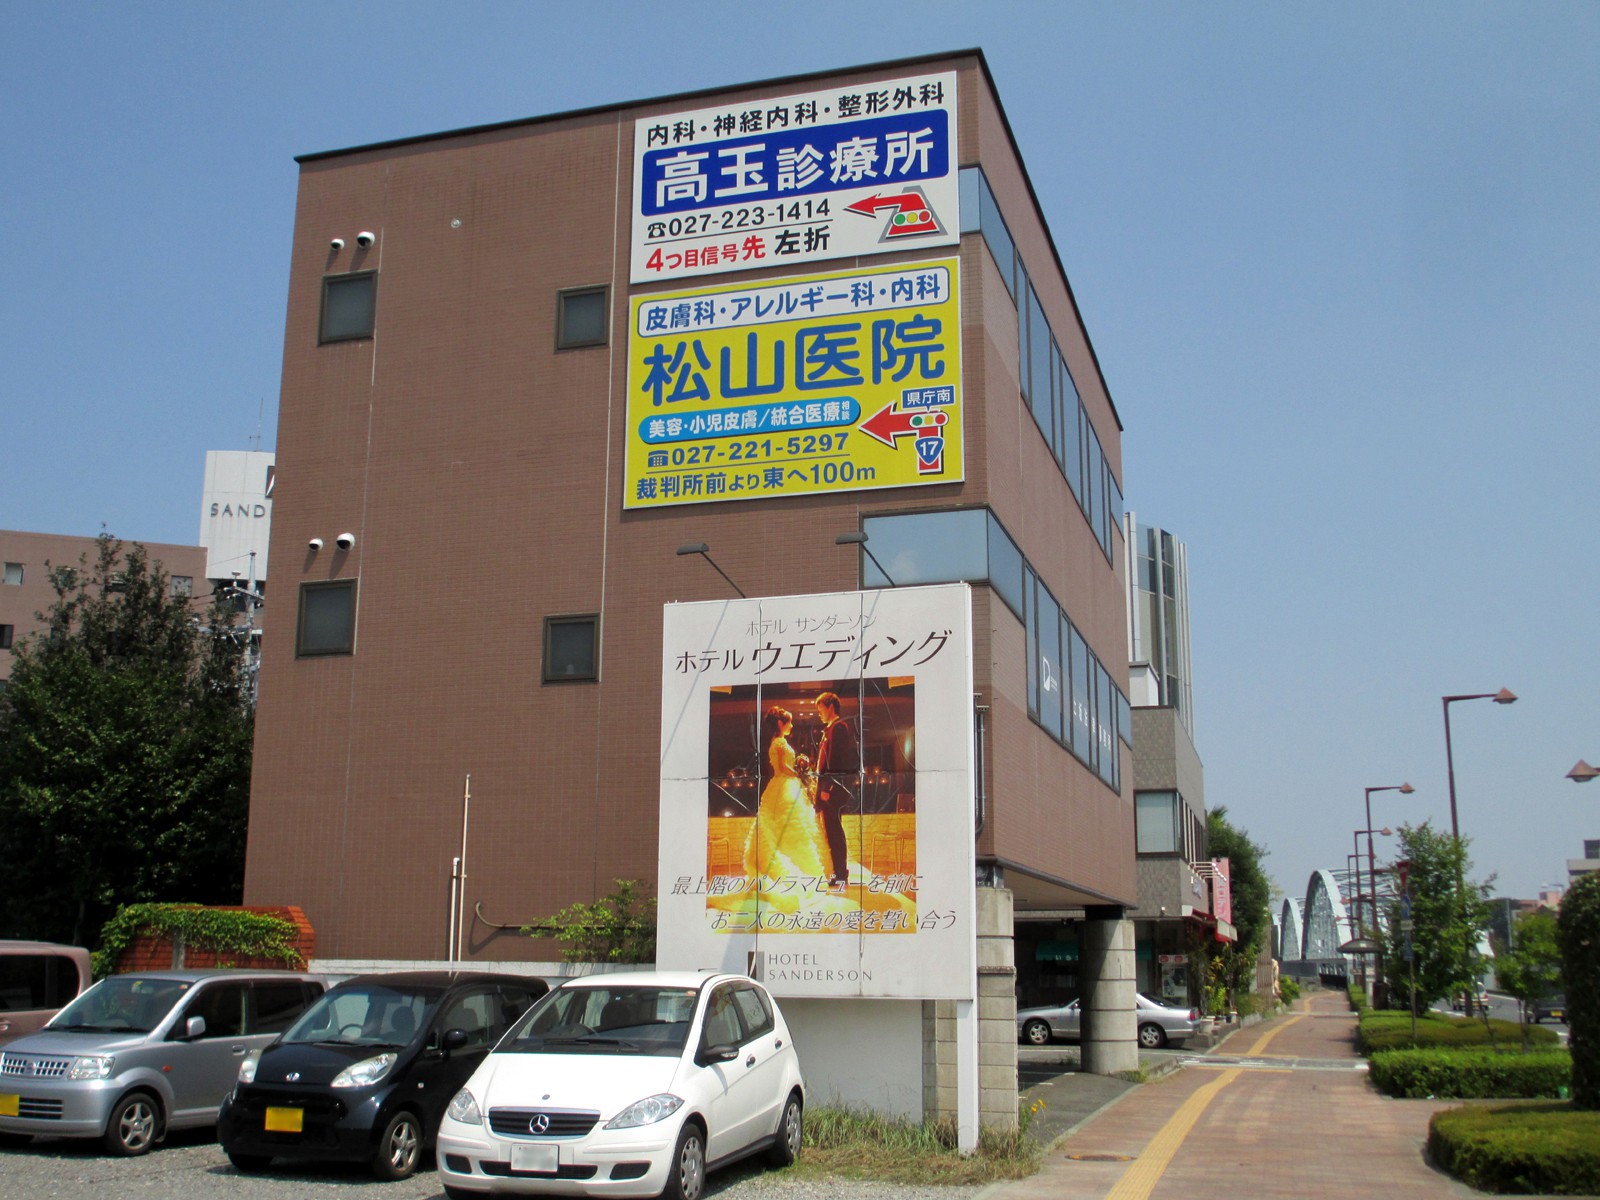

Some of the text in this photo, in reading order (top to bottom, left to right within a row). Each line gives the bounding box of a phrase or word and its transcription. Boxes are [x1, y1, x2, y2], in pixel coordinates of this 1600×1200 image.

[647, 81, 945, 147] 内科・神経内科・整形外科
[655, 127, 934, 207] 高玉診療所
[668, 199, 831, 236] 027-223-1414
[645, 225, 831, 272] 4つ目信号先 左折
[646, 273, 940, 331] 皮膚科・アレルギー科・内科
[641, 314, 945, 406] 松山医院
[907, 389, 951, 406] 県庁南
[671, 433, 850, 465] 027-221-5297
[920, 441, 939, 456] 17
[637, 461, 876, 500] 裁判所前より東へ100m
[210, 502, 266, 518] SAND
[746, 614, 878, 636] ホテル サンダーソン
[670, 873, 924, 897] 最上階のパノラマビューを前に
[710, 909, 958, 931] お二人の永遠の愛を誓い合う
[768, 953, 819, 966] HOTEL
[768, 969, 874, 982] SANDERSON
